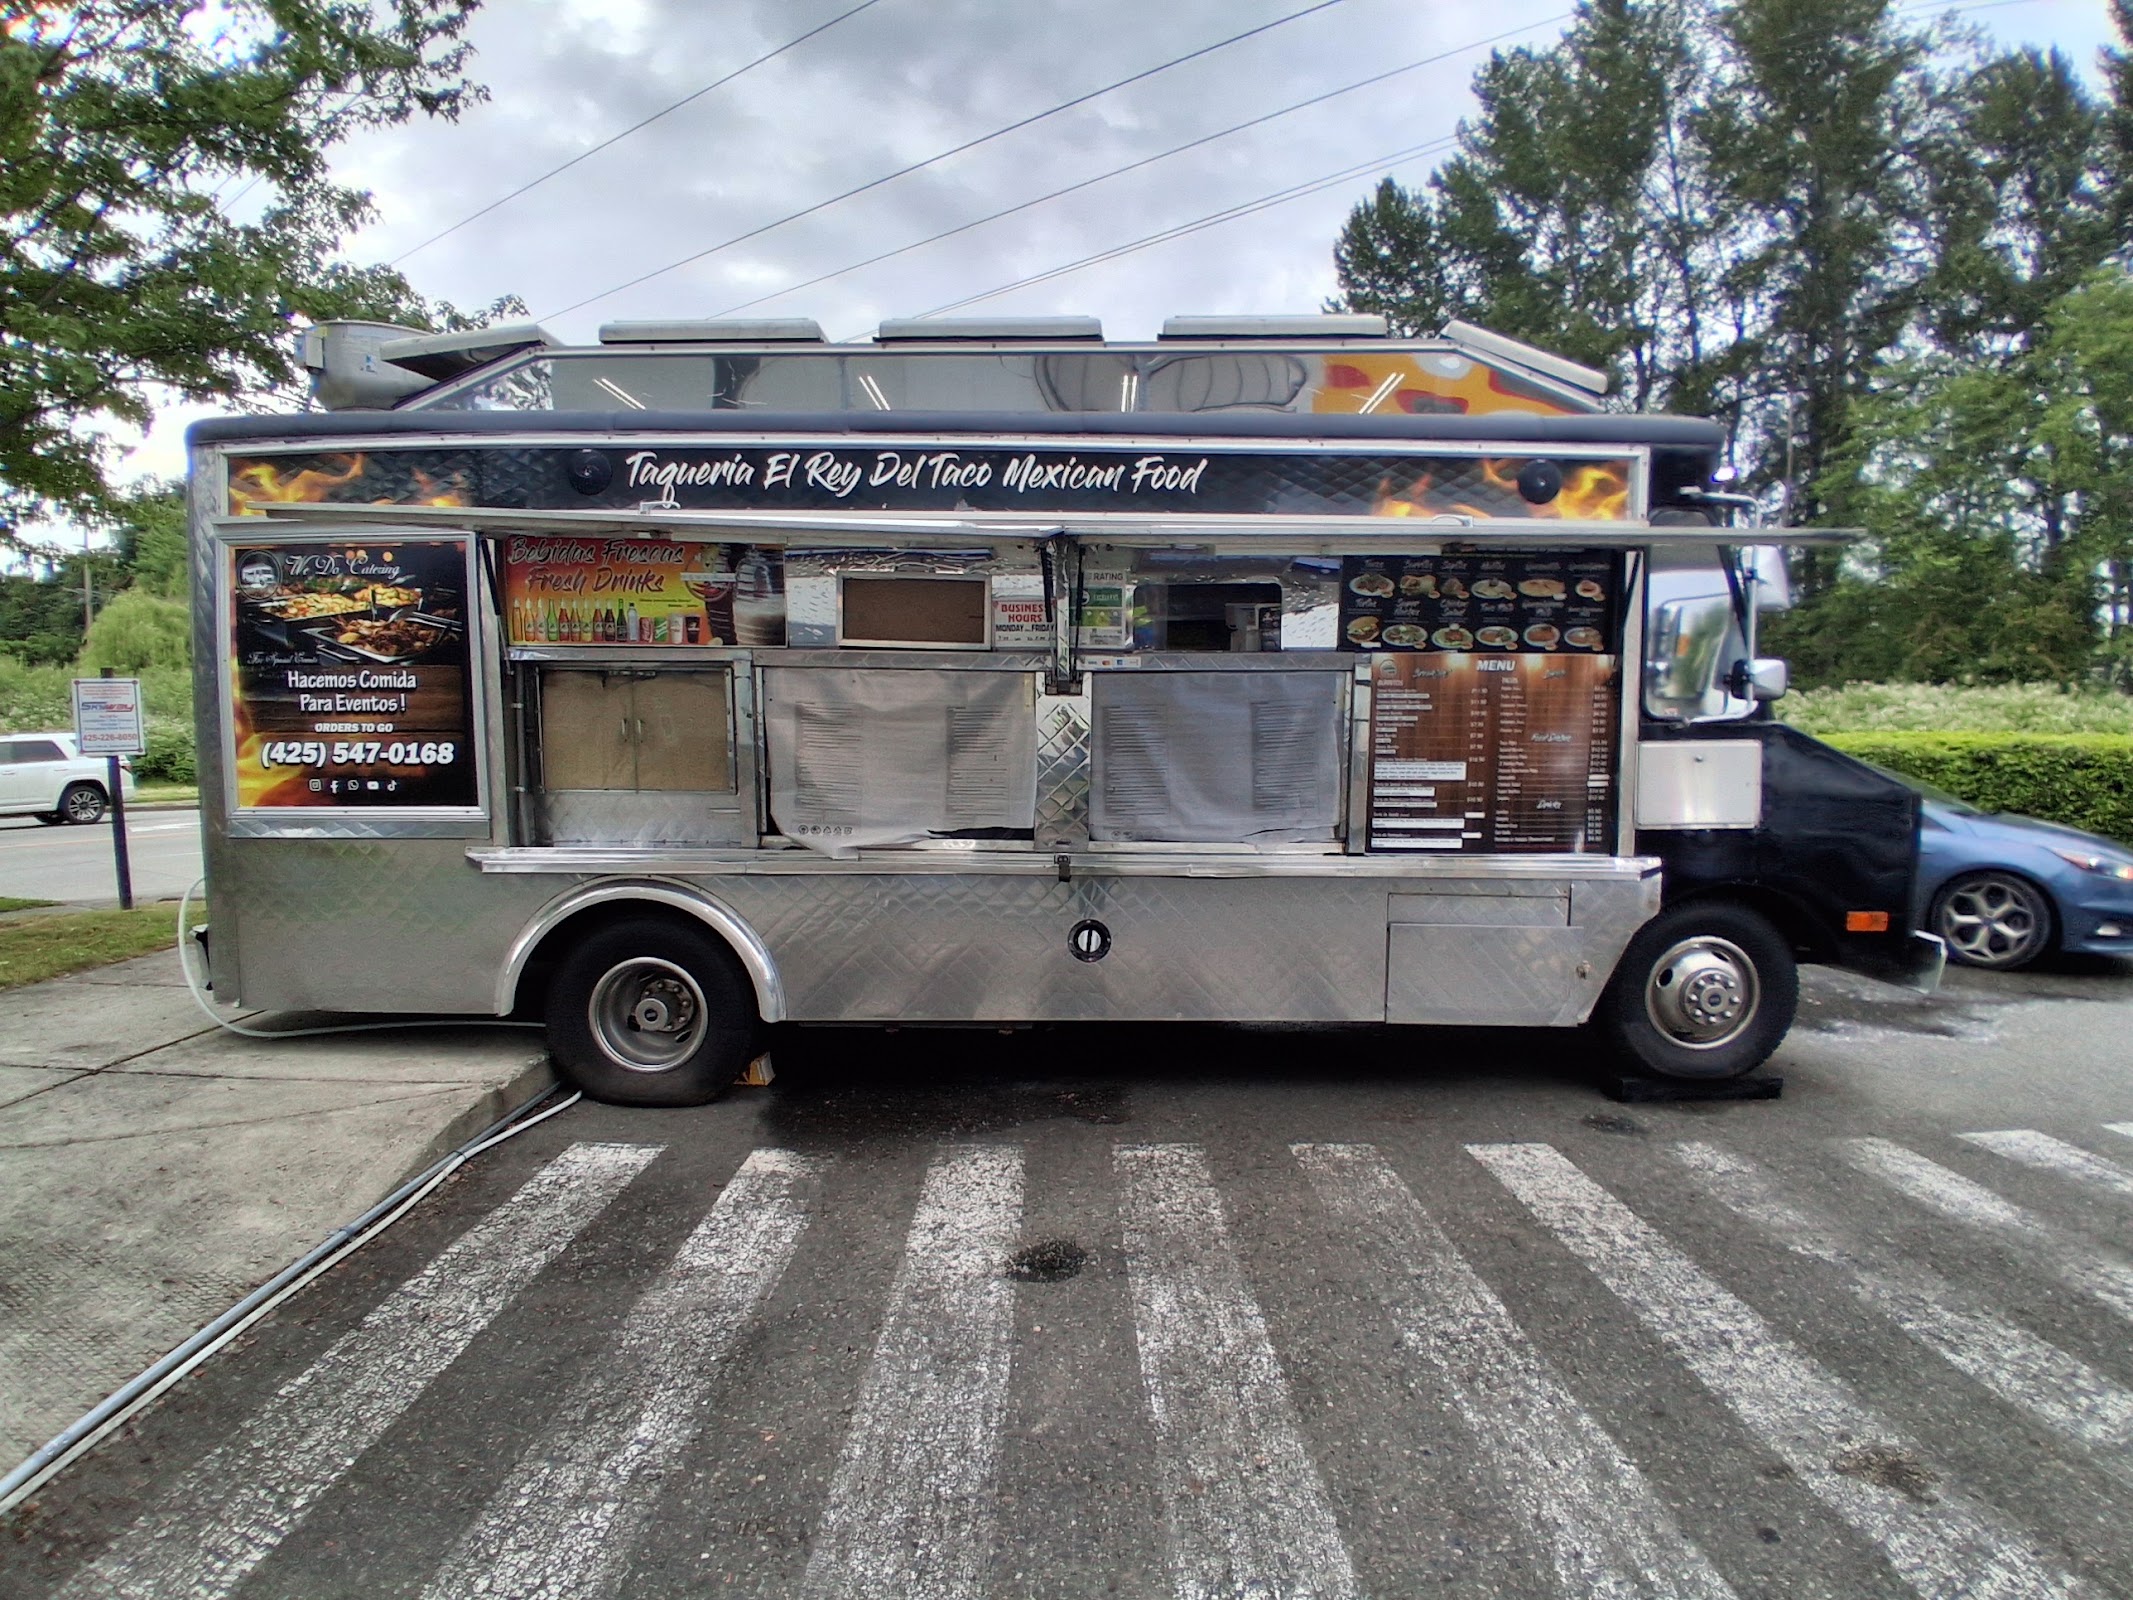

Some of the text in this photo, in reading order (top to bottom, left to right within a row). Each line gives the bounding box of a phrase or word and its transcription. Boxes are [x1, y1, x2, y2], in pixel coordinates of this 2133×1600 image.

[626, 452, 1208, 507] Taqueria El Rey Del Taco Mexican Food
[508, 538, 684, 565] Bebidas Frescas
[285, 555, 400, 580] We Do Catering
[1093, 573, 1123, 581] RATING
[526, 566, 664, 595] Fresh Drinks
[1001, 604, 1045, 613] BUSINES
[996, 624, 1024, 632] MONDAY
[1008, 614, 1043, 623] HOURS
[1476, 660, 1516, 671] MENU
[287, 670, 417, 689] Hacemos Comida
[299, 693, 333, 712] Para
[335, 693, 398, 712] Eventos
[314, 723, 394, 733] ORDERS TO GO
[261, 741, 455, 768] (425) 547-0168
